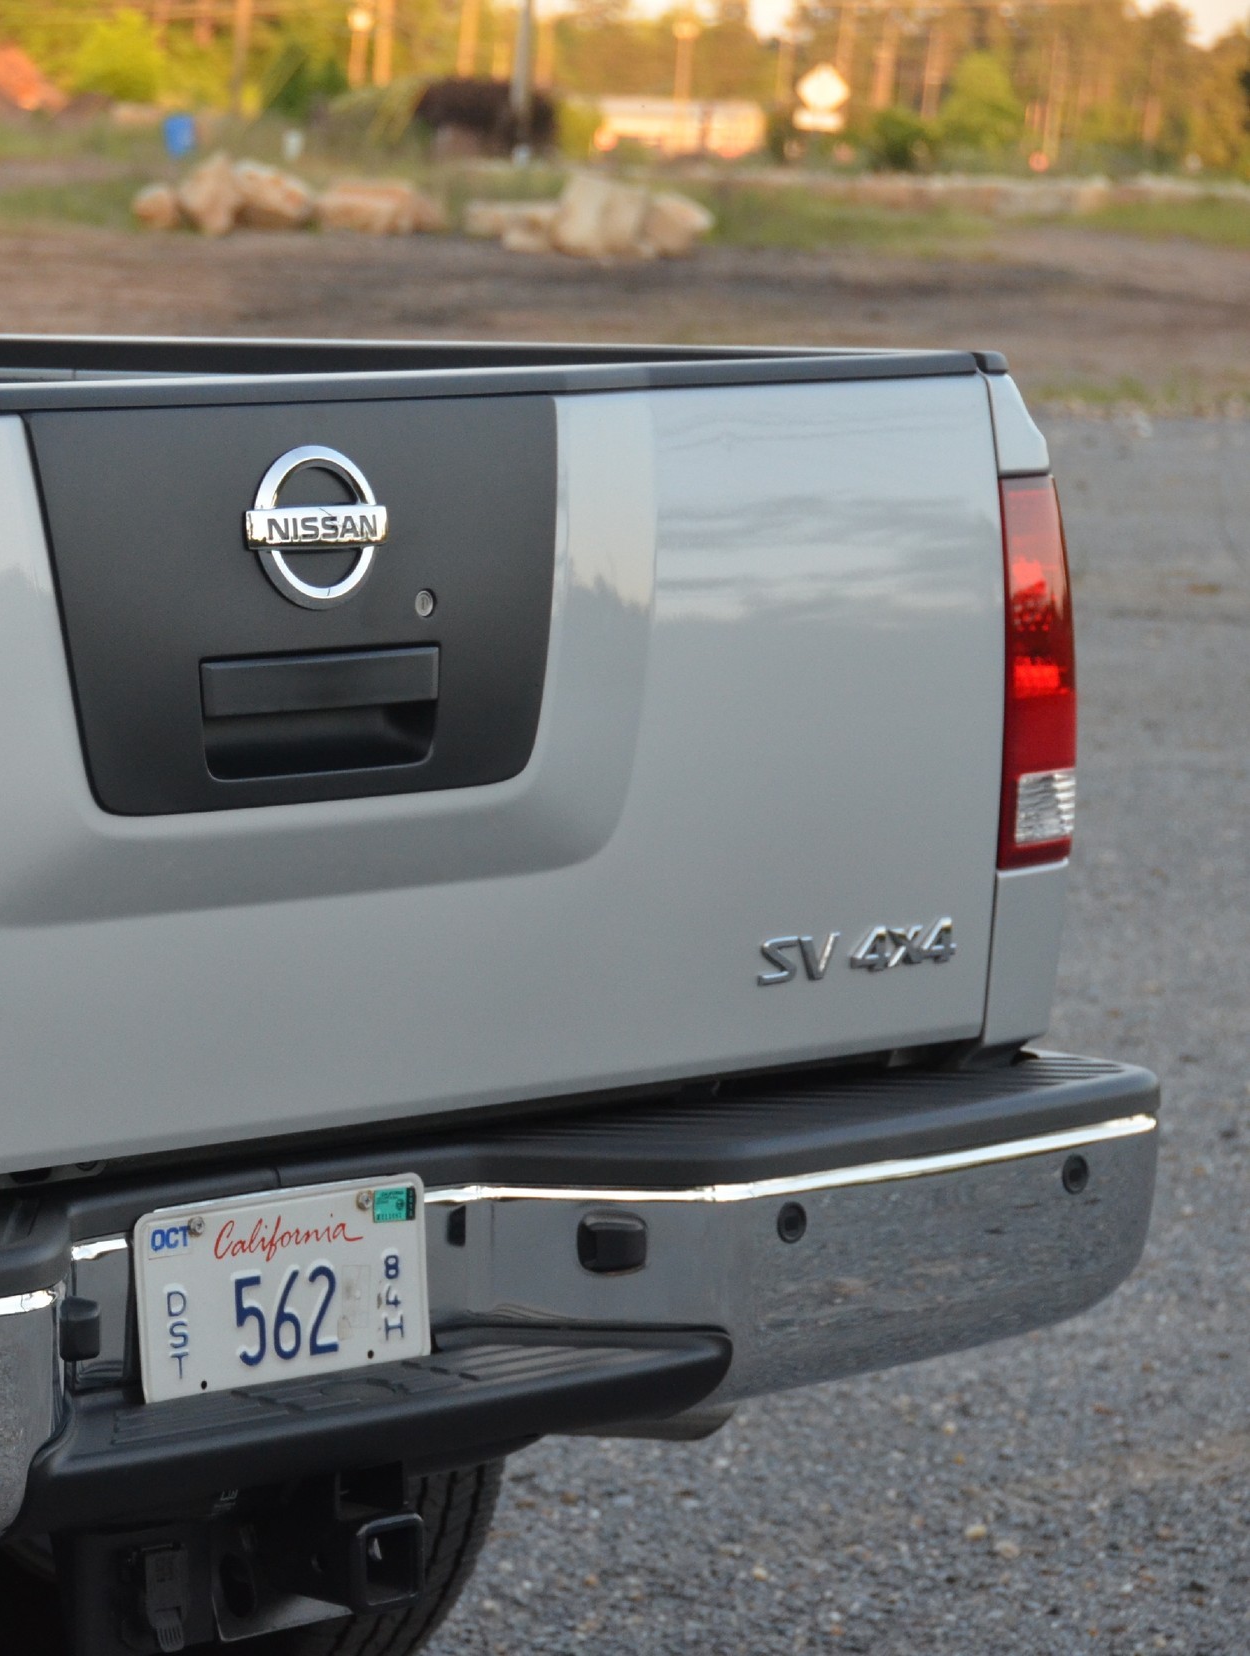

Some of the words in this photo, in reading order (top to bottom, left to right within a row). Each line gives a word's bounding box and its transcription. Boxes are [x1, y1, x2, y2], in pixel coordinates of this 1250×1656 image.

[266, 513, 378, 541] NISSAN
[757, 931, 841, 986] SV
[150, 1225, 191, 1251] OCT
[213, 1213, 364, 1263] California
[234, 1263, 340, 1367] 562
